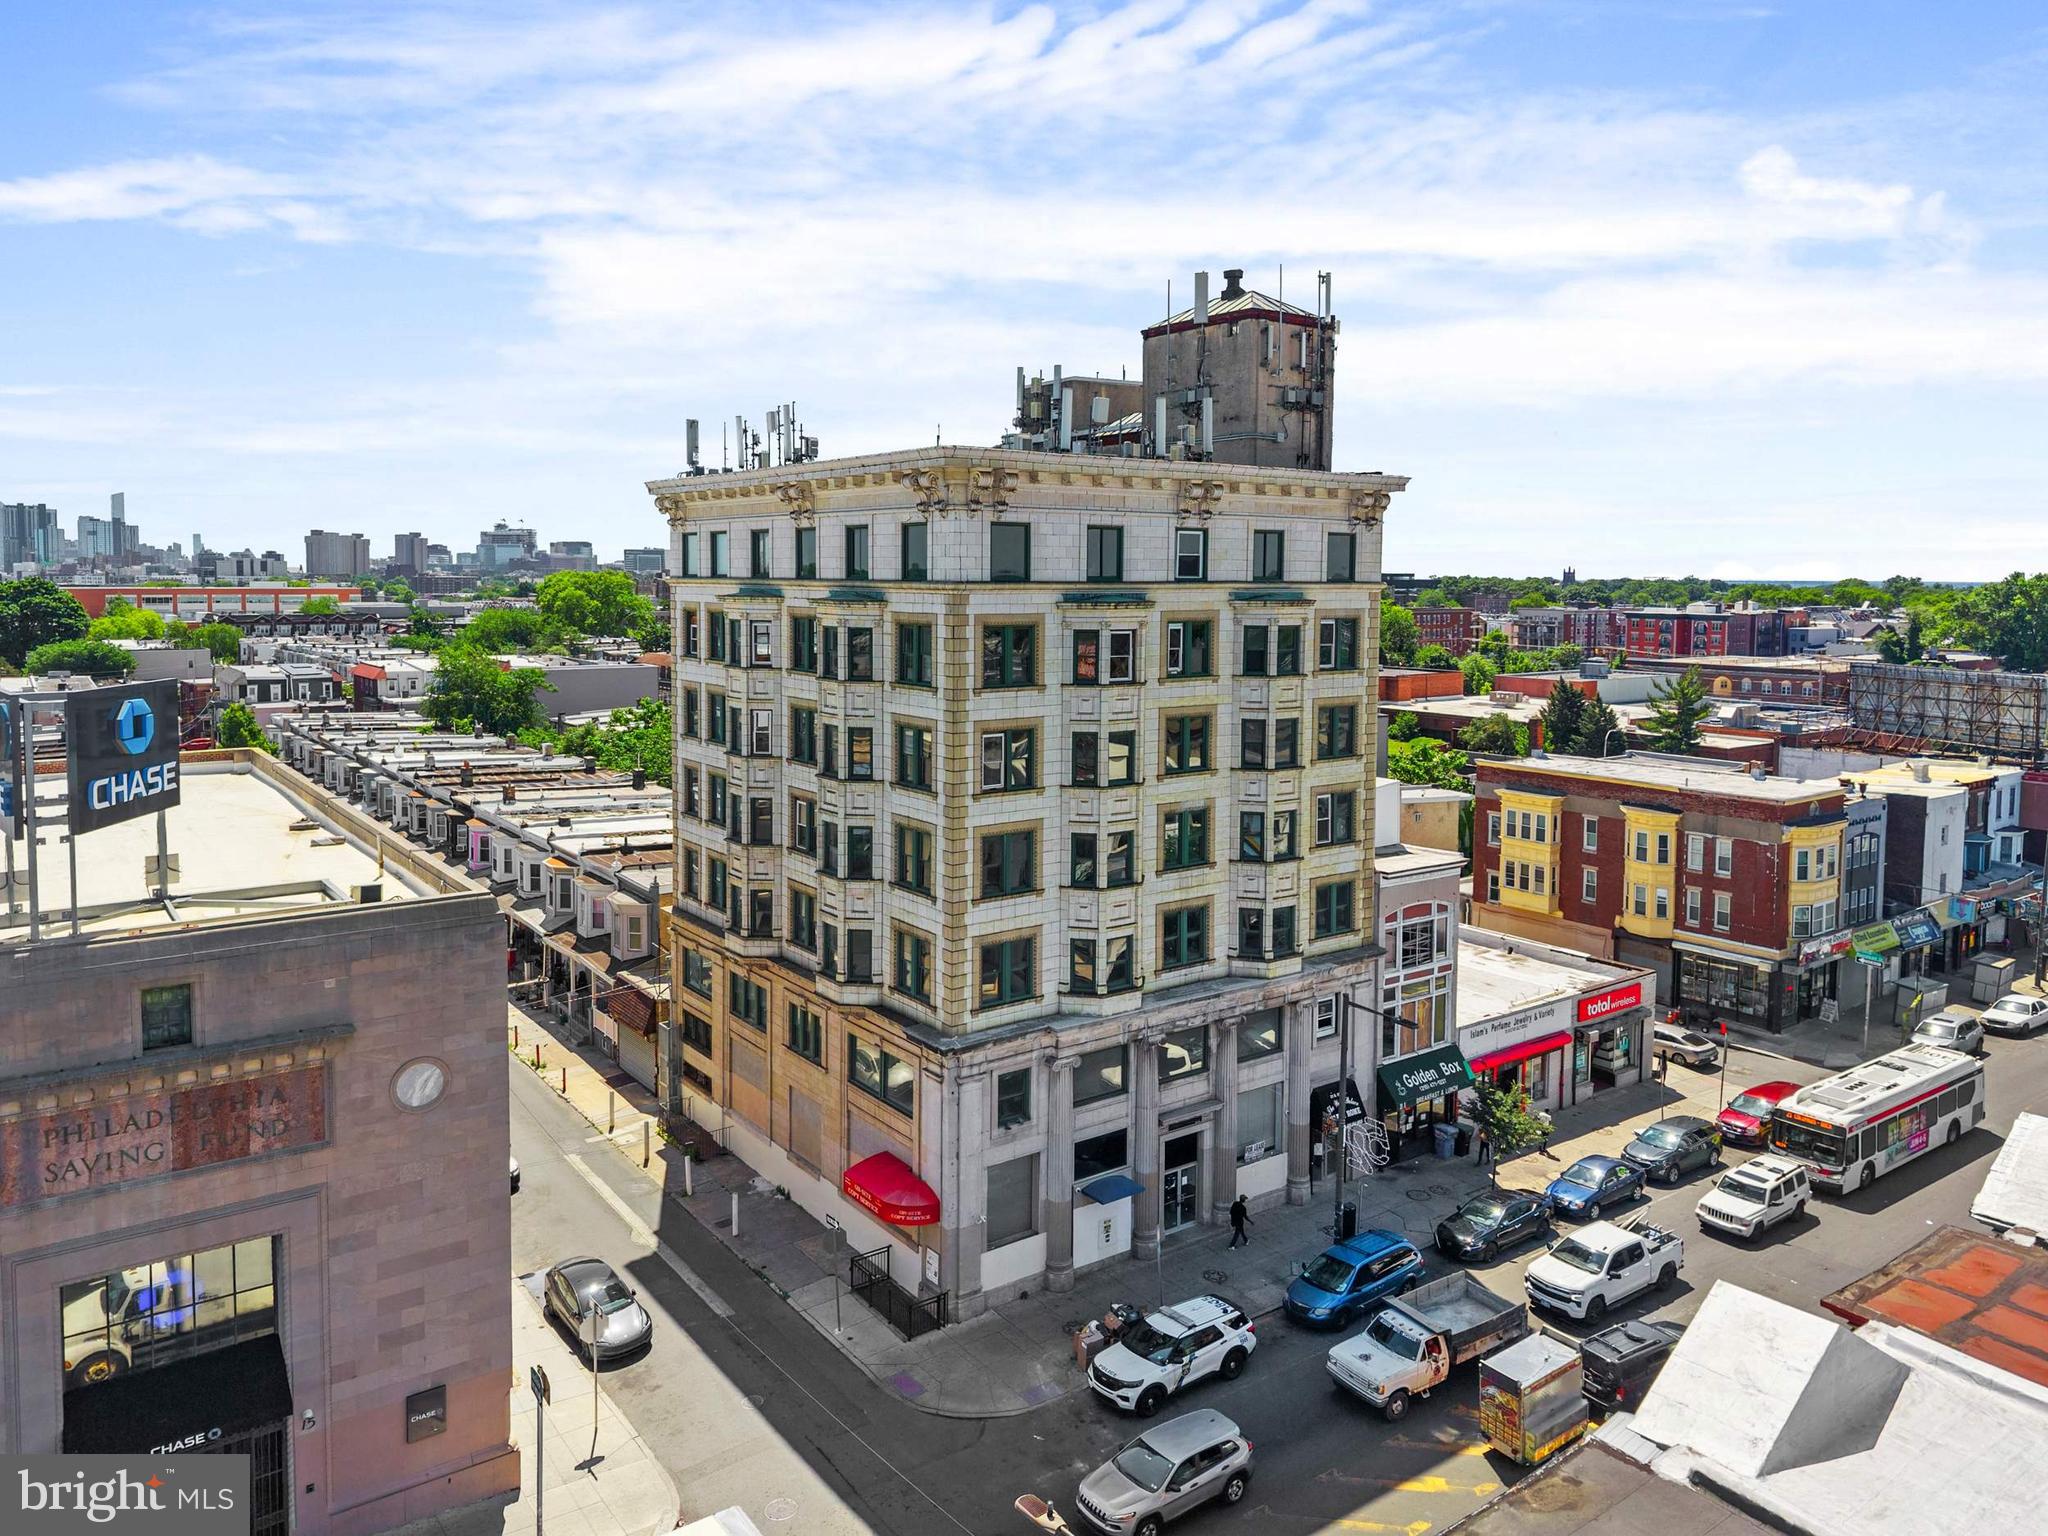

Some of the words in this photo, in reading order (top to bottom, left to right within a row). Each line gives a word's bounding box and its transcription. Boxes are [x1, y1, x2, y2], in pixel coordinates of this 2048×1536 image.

[90, 761, 177, 810] CHASE
[1587, 996, 1610, 1016] total
[1610, 995, 1636, 1009] wireless
[1470, 1025, 1488, 1039] Islam's
[1491, 1020, 1511, 1033] Perfume
[1513, 1015, 1532, 1028] Jewelry
[1538, 1007, 1555, 1019] Variety
[1402, 1069, 1438, 1088] Golden
[1439, 1061, 1462, 1076] Box
[43, 1142, 165, 1184] SAVING
[200, 1117, 288, 1151] FUND
[410, 1409, 436, 1423] CHASE
